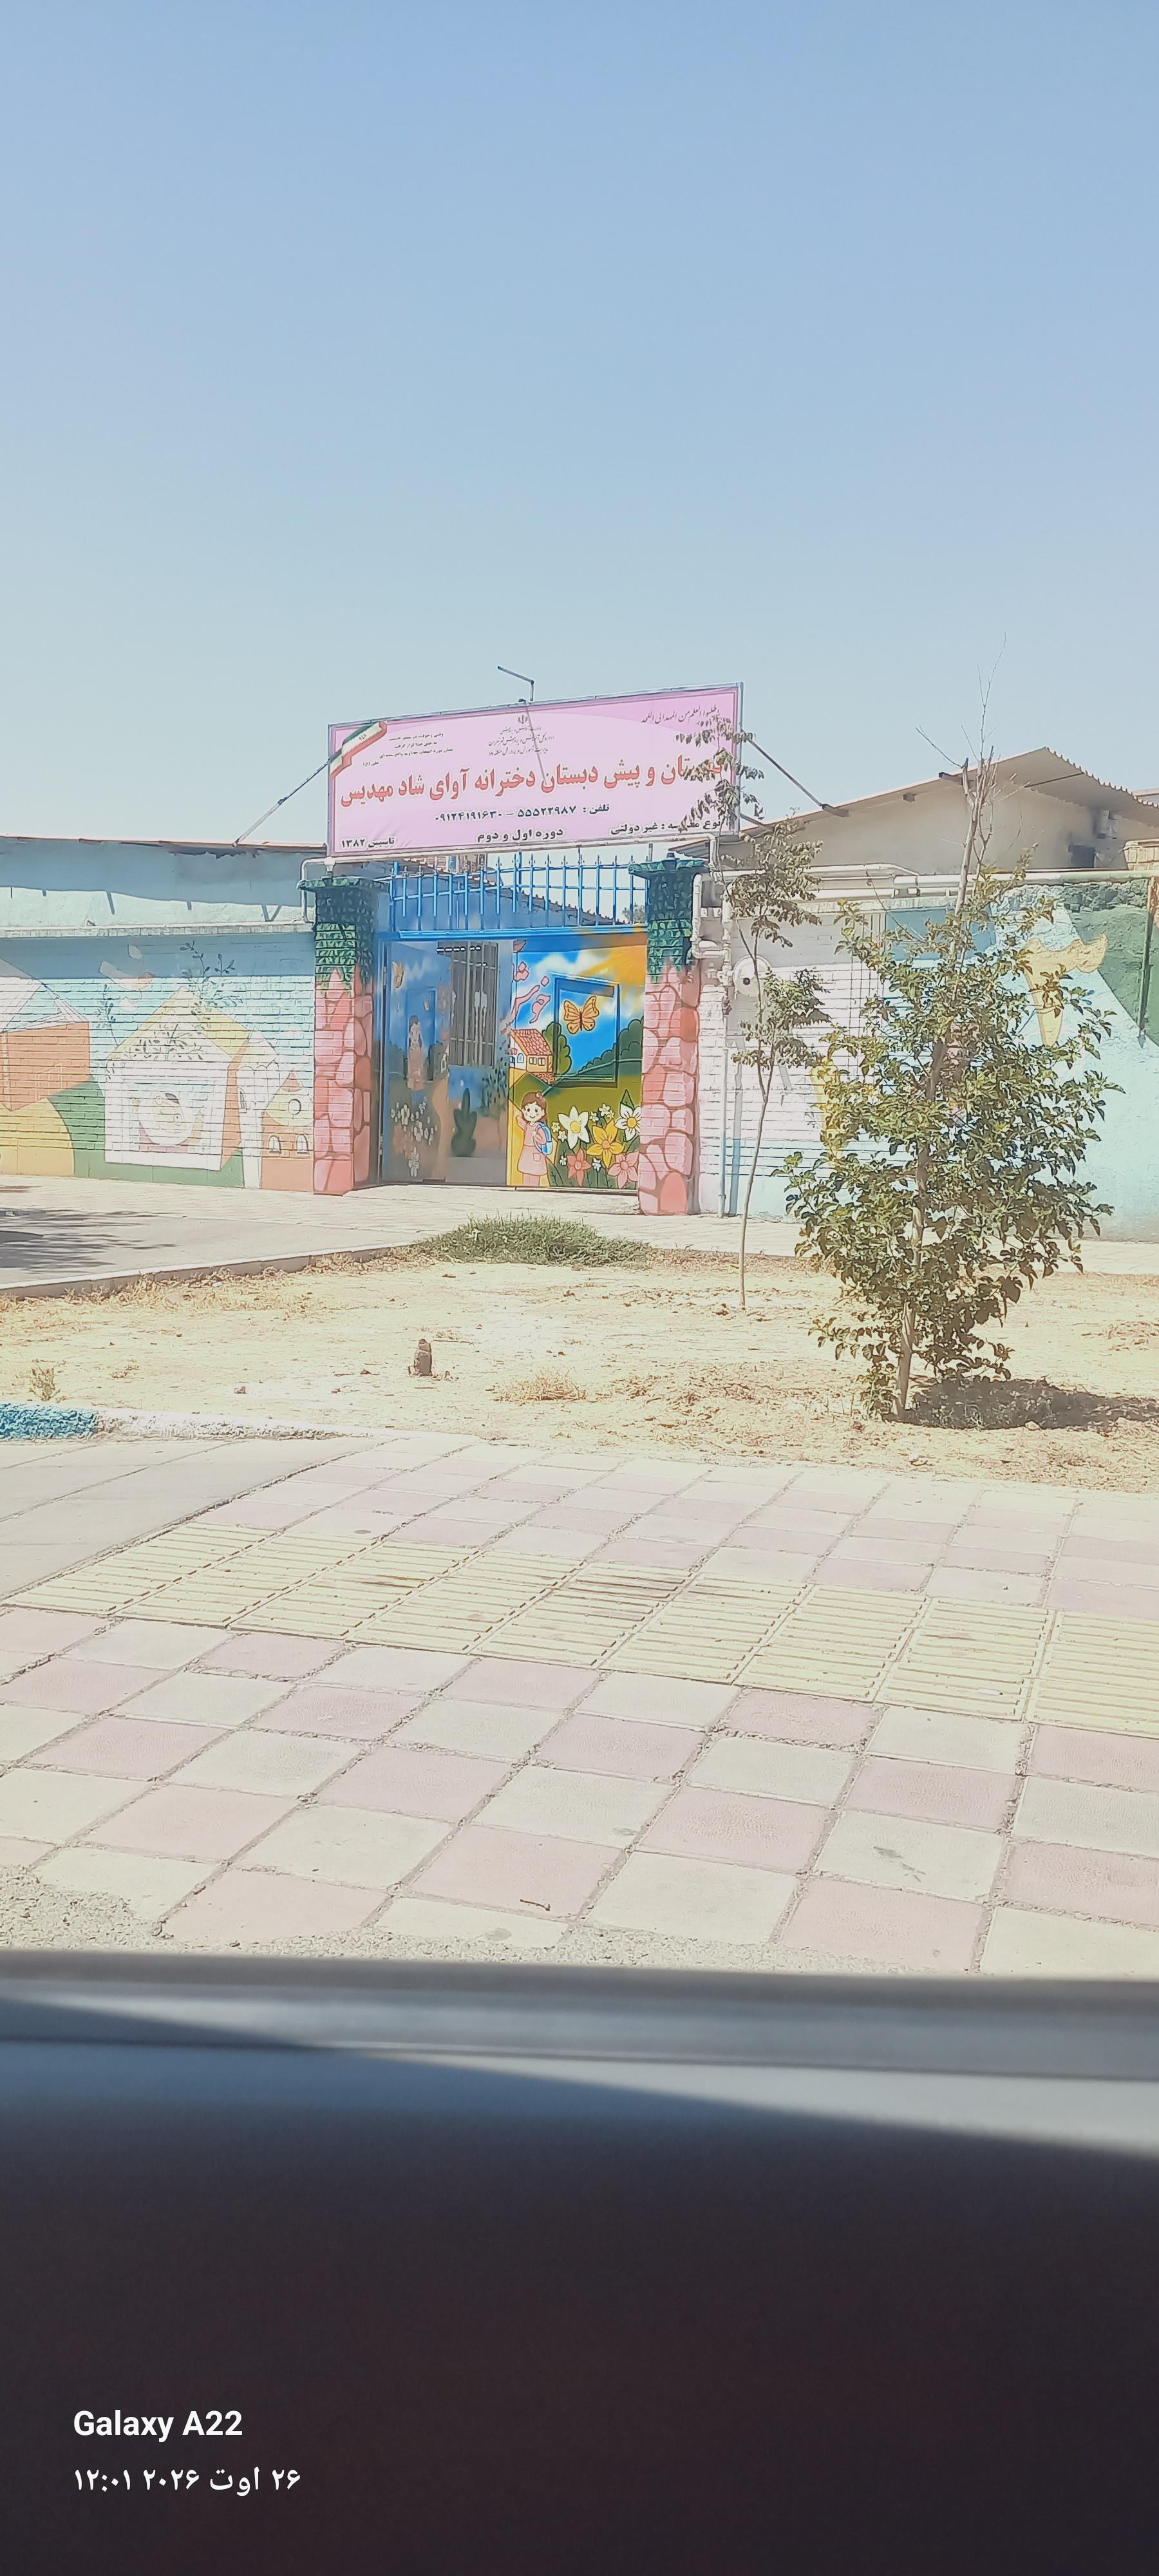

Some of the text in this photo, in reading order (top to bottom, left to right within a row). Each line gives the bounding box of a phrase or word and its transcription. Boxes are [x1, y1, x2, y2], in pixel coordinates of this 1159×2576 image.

[678, 710, 690, 723] من
[542, 764, 598, 793] دبستان
[604, 759, 640, 788] پیش
[645, 766, 655, 786] و
[398, 774, 424, 796] شاد
[429, 767, 469, 800] آوای
[475, 767, 536, 797] دخترانه
[341, 782, 393, 807] مهدیس
[517, 805, 577, 817] ۵۵۵۲۲۹۸۷
[589, 804, 610, 815] تلفن
[610, 824, 640, 835] دولتی
[643, 822, 658, 833] غیر
[702, 820, 721, 830] نوع
[368, 837, 395, 848] تاسیس
[477, 829, 563, 843] دوره اول و دوم
